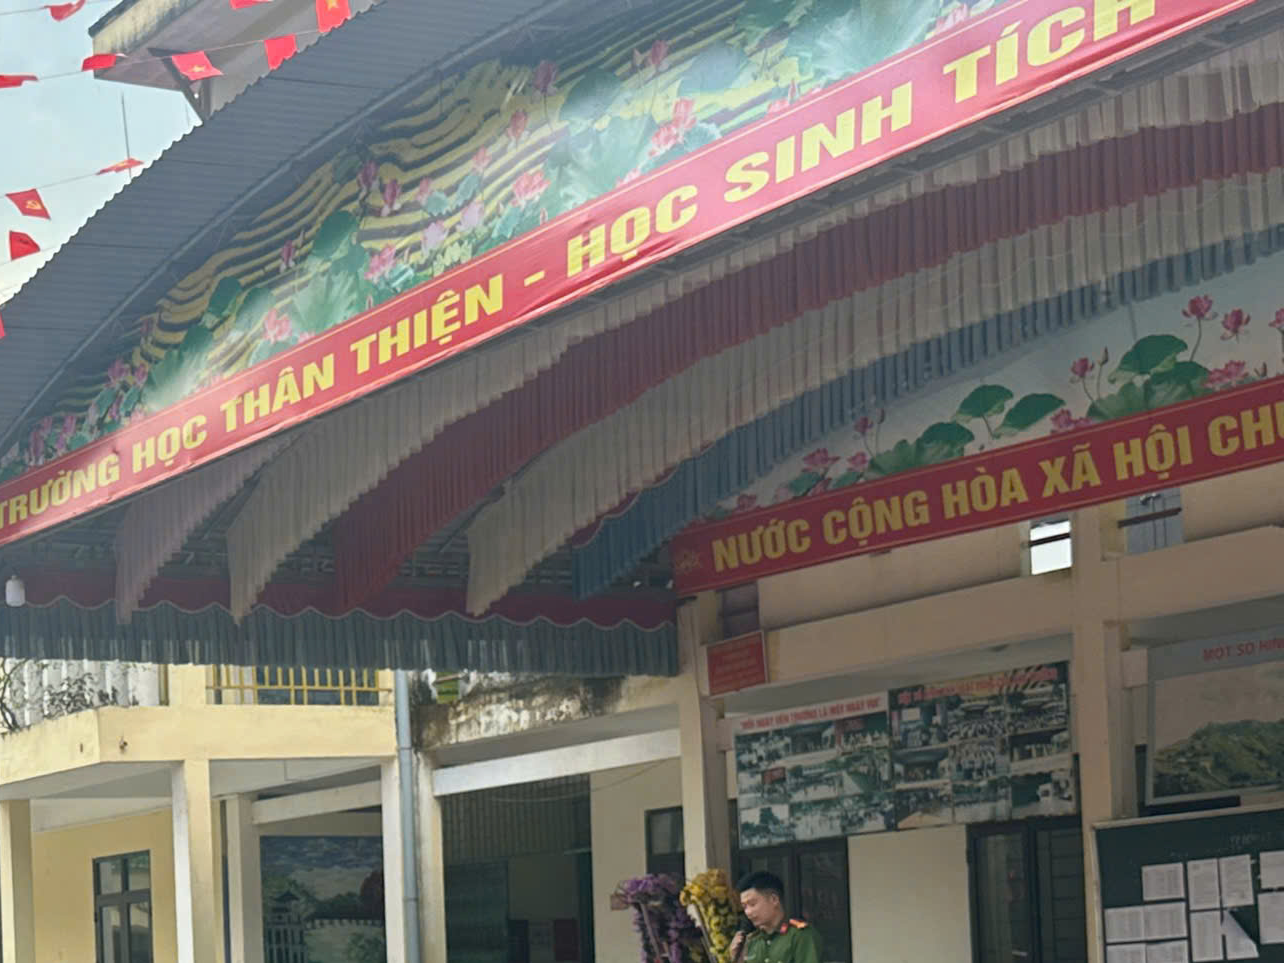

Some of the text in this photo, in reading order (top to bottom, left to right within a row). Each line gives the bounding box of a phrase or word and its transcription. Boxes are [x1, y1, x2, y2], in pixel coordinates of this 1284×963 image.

[132, 415, 208, 473] HỌC
[219, 353, 335, 432] THÂN
[350, 274, 504, 375] THIỆN
[567, 184, 698, 277] HỌC
[724, 81, 913, 202] SINH
[942, 0, 1155, 104] TÍCH
[712, 399, 1284, 573] NƯỚC CỘNG HÒA XÃ HỘI CH
